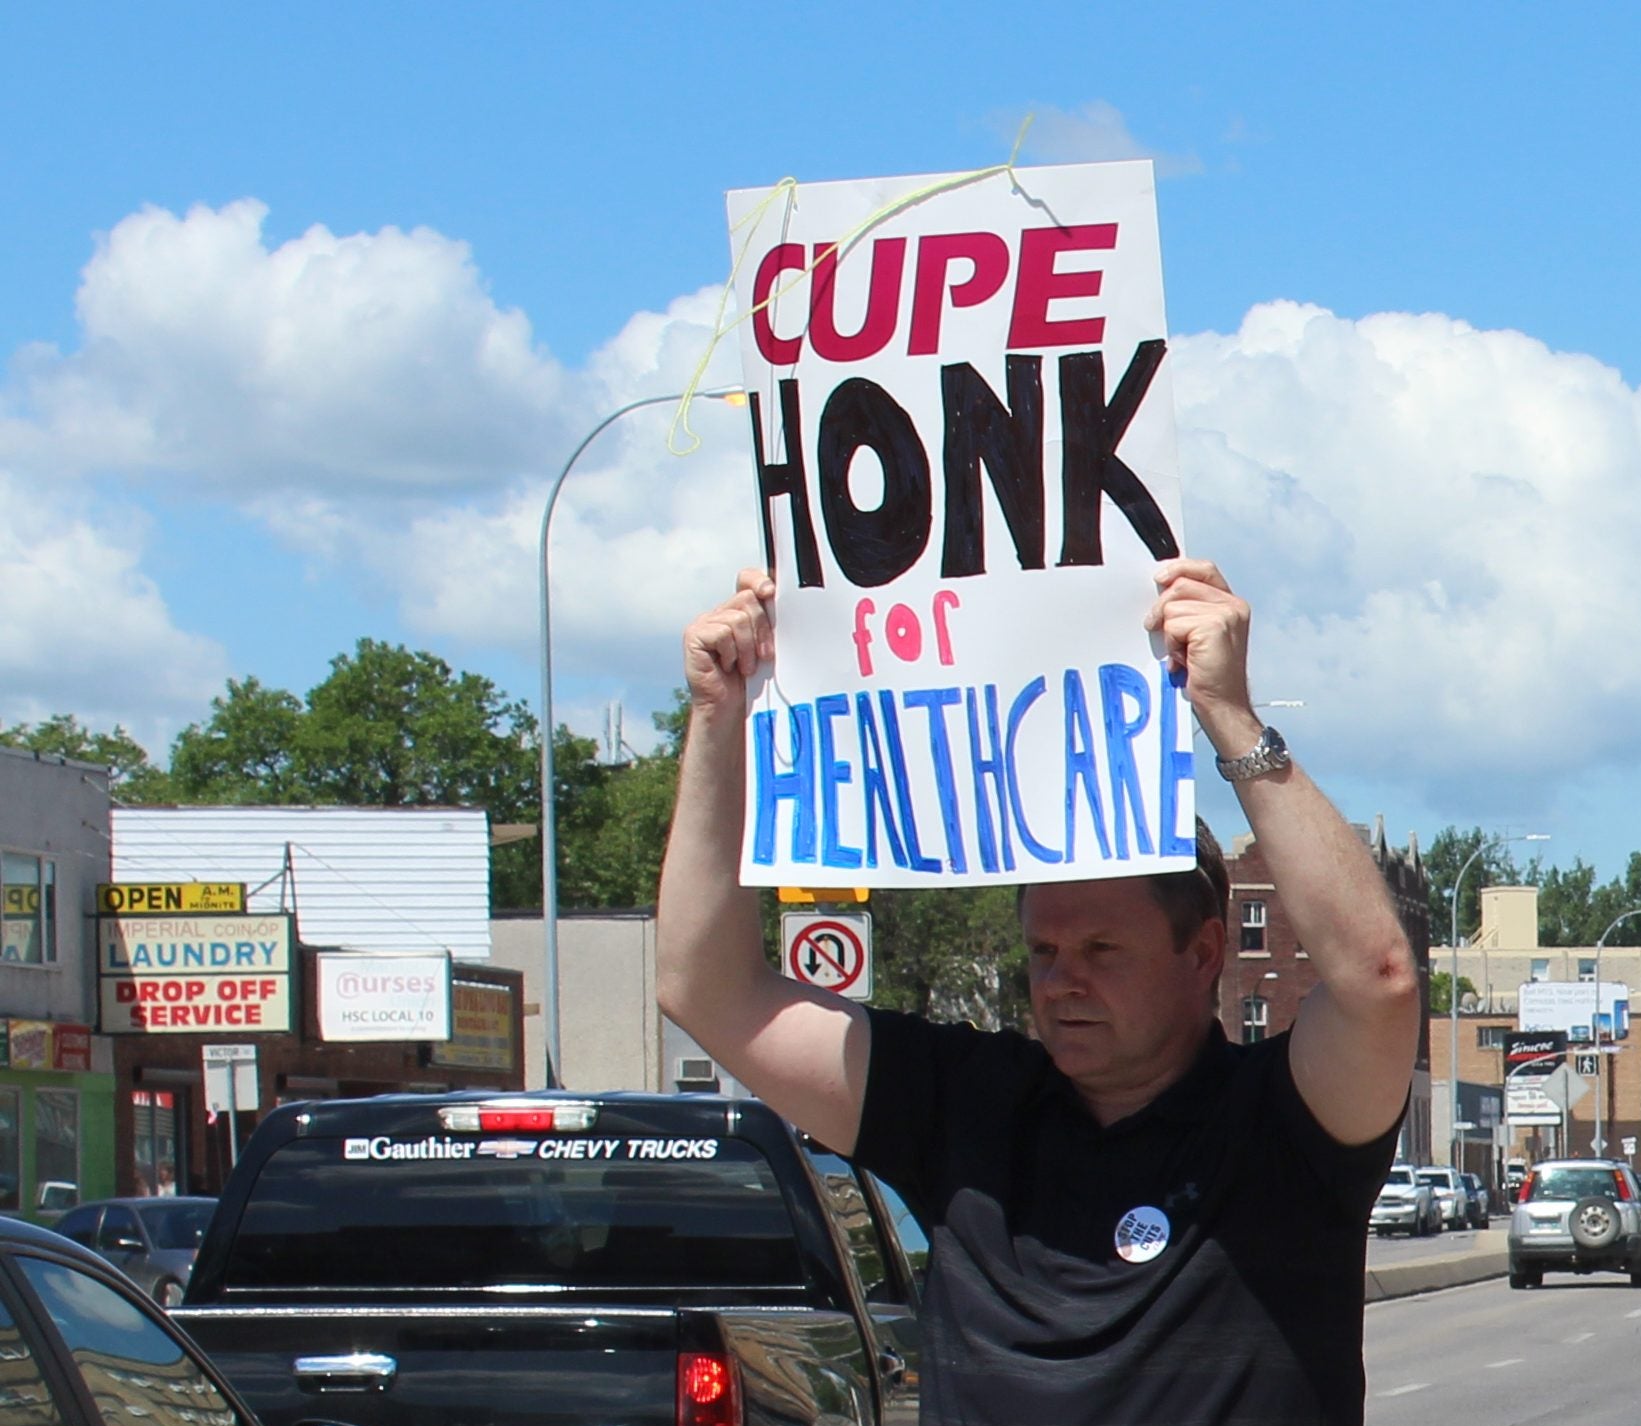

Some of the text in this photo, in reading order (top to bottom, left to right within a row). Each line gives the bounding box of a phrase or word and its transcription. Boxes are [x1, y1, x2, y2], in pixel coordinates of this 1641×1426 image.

[752, 222, 1118, 366] CUPE
[750, 339, 1180, 588] HONK
[854, 590, 959, 676] for
[751, 660, 1196, 876] HEALTHCARE
[105, 886, 234, 910] OPEN A.M.
[108, 920, 279, 939] IMPERIAL COIN-OP
[109, 941, 277, 968] LAUNDRY
[116, 979, 277, 1003] DROP OFF
[337, 973, 435, 998] nurses
[130, 1004, 262, 1028] SERVICE
[342, 1010, 434, 1022] HSC LOCAL 10
[370, 1137, 475, 1160] Gauthier
[539, 1139, 618, 1159] CHEVY
[627, 1139, 717, 1159] TRUCKS
[1130, 1222, 1148, 1241] THE
[1140, 1224, 1161, 1251] CUTS
